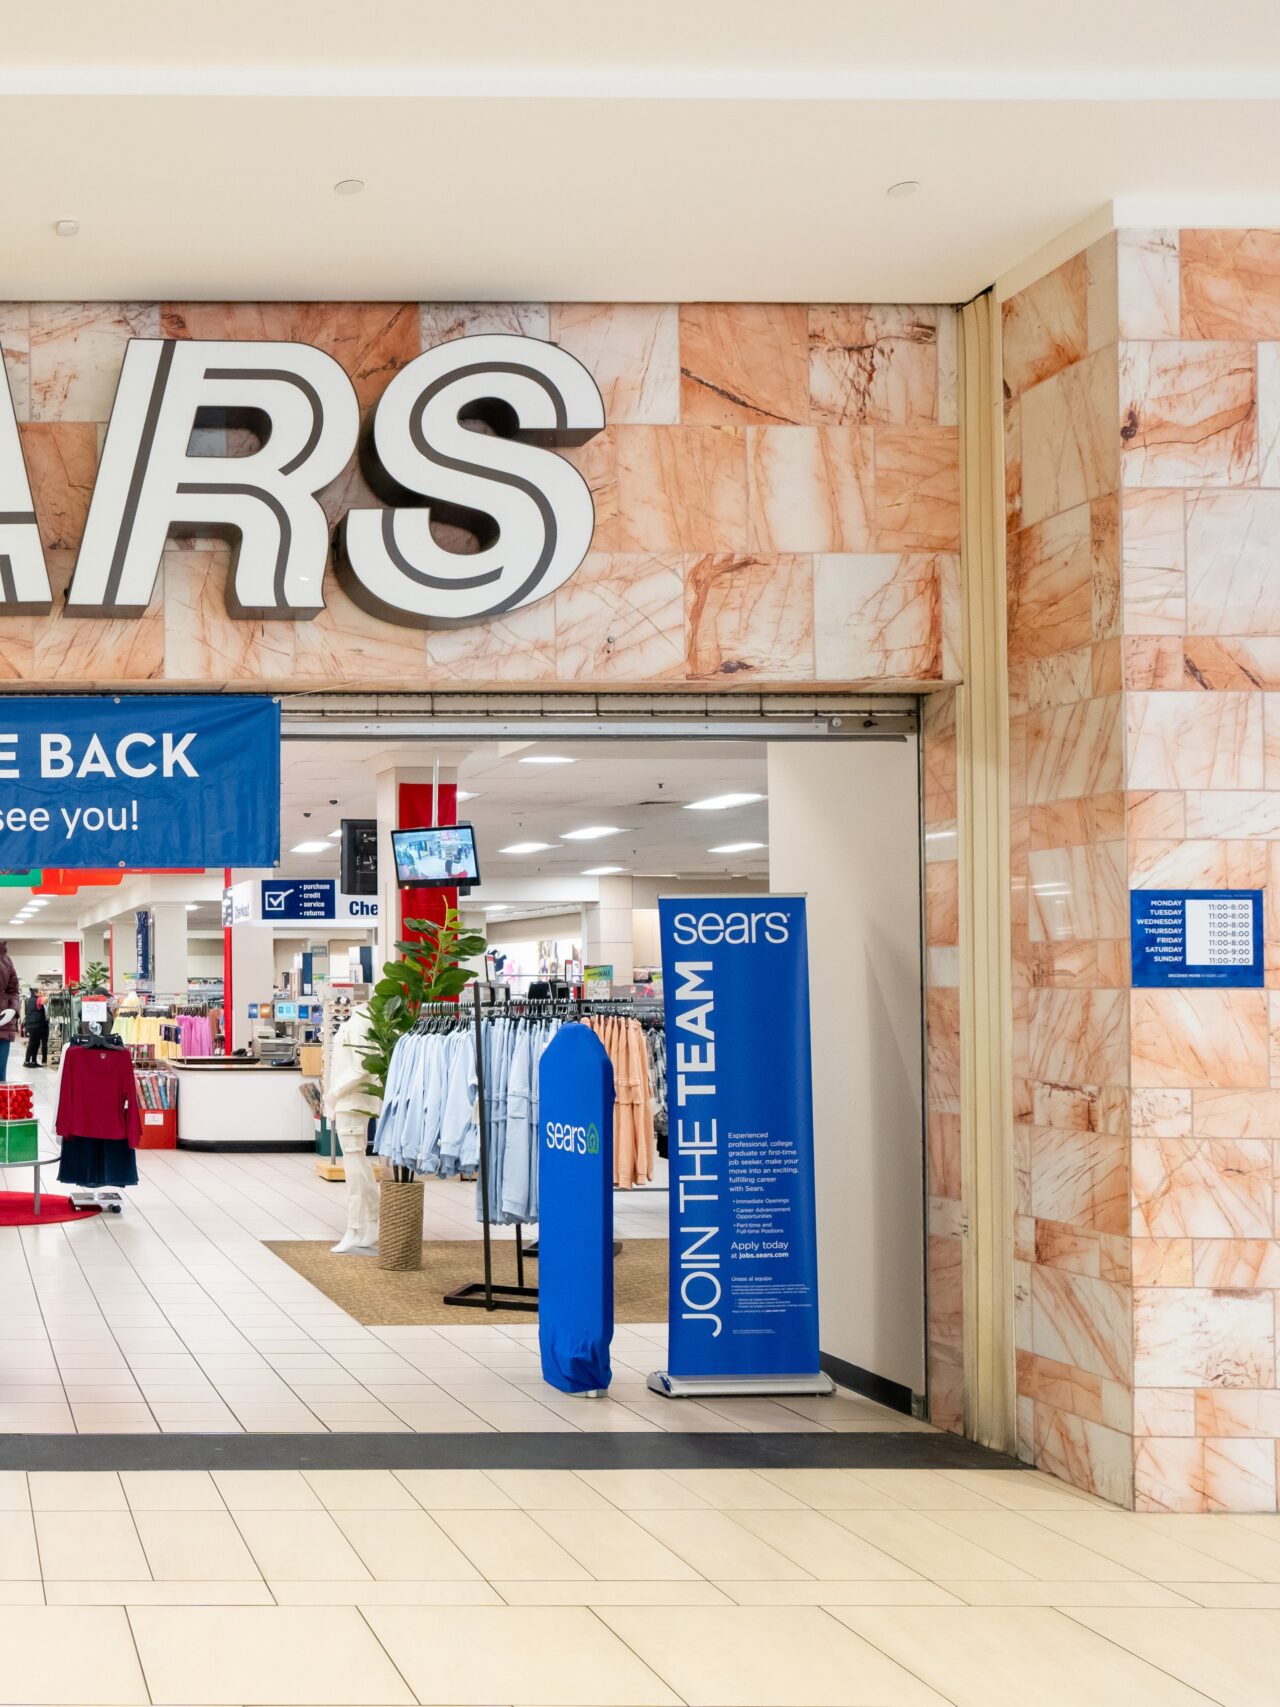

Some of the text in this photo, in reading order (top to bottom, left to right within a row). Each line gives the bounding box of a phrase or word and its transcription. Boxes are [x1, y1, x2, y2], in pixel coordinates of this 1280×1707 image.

[40, 732, 200, 779] BACK
[60, 800, 140, 840] you!
[303, 883, 330, 891] purchase
[349, 900, 378, 916] Che
[672, 911, 790, 945] sears
[546, 1121, 586, 1155] sears
[674, 961, 723, 1338] JOIN THE TEAM
[731, 1240, 789, 1251] Apply today
[739, 1252, 789, 1260] jobs.sears.com
